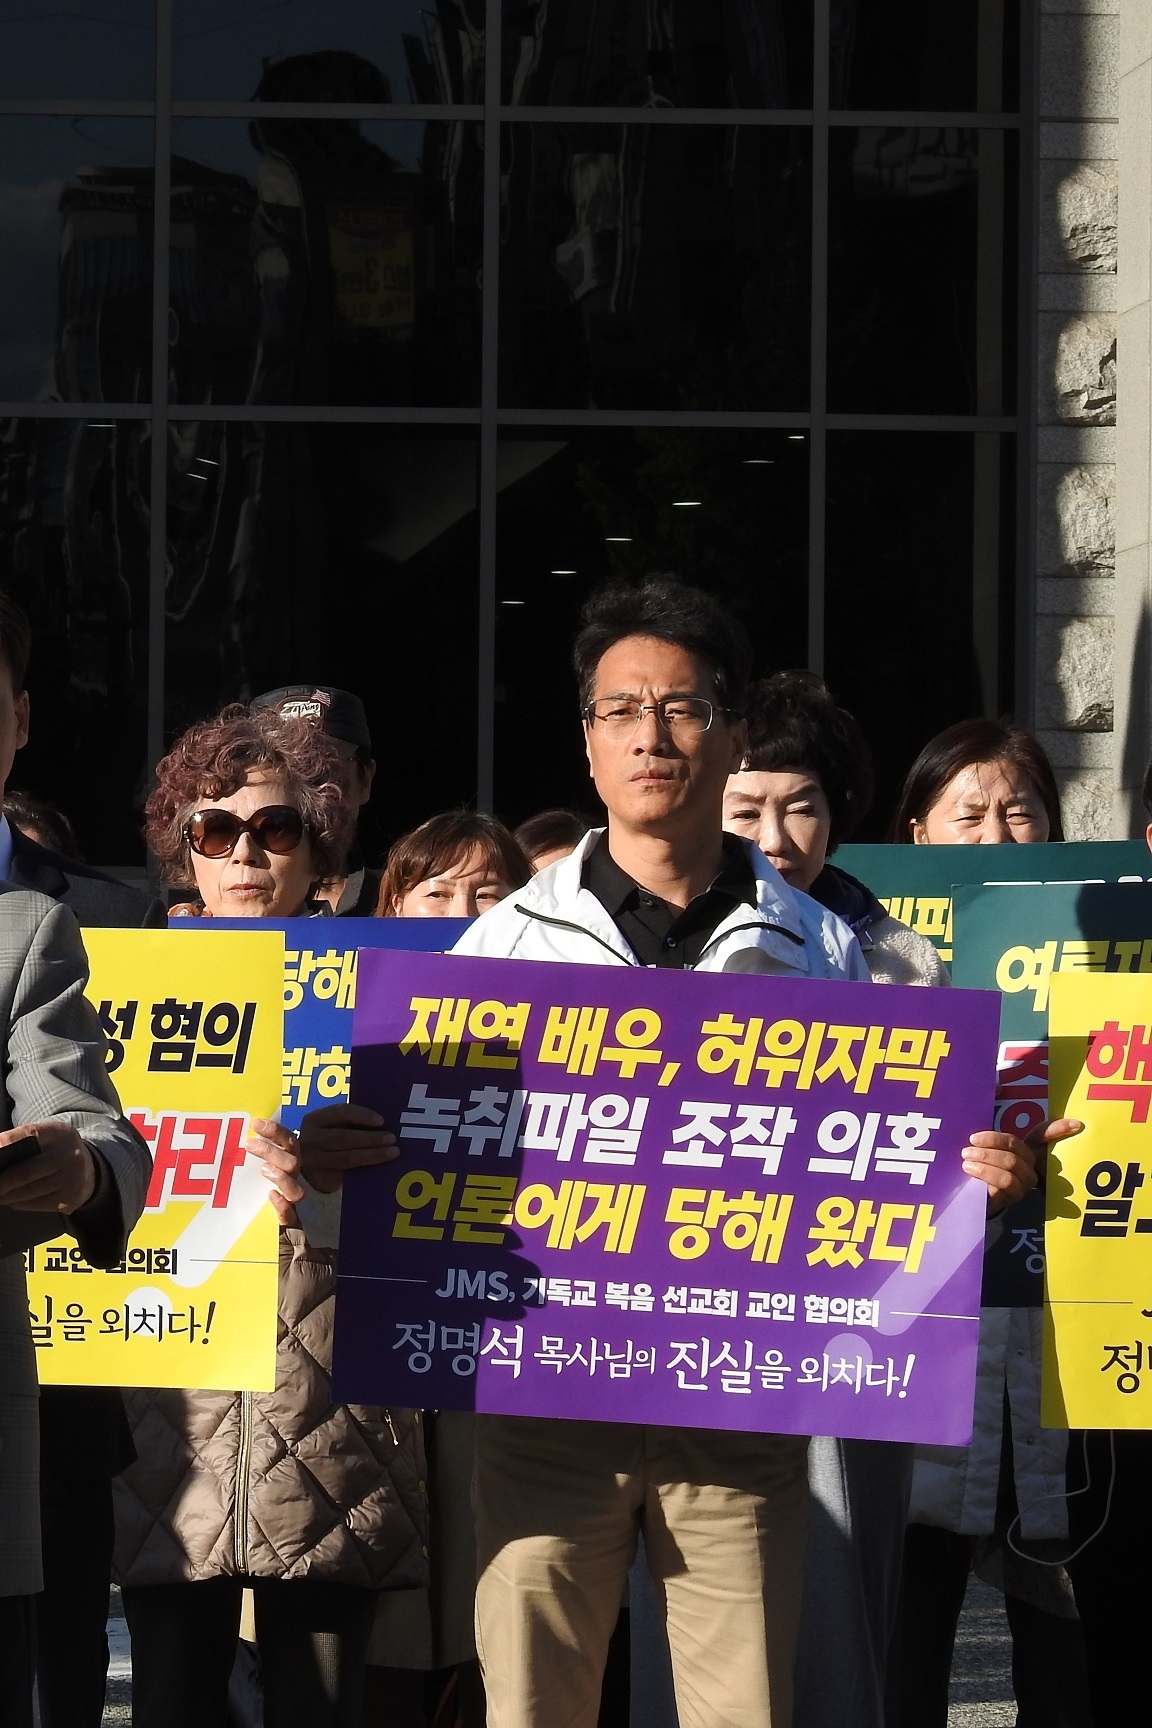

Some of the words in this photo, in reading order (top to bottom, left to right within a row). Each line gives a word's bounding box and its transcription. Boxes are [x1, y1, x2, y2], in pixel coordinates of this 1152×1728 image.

[148, 998, 258, 1073] 혐의
[399, 996, 531, 1069] 재연
[537, 1005, 681, 1087] 배우,
[696, 1013, 950, 1099] 허위자막
[662, 1102, 798, 1176] 조작
[808, 1112, 942, 1186] 의혹
[391, 1169, 647, 1254] 언론에게
[664, 1188, 792, 1265] 당해
[805, 1195, 936, 1274] 왔다
[1080, 1160, 1152, 1238] 알
[99, 1301, 216, 1345] 외치다!
[435, 1268, 517, 1304] JMS,
[522, 1276, 597, 1308] 기독교
[603, 1282, 655, 1312] 복음
[662, 1285, 739, 1317] 선교회
[745, 1291, 795, 1322] 교인
[803, 1294, 880, 1328] 협의회
[392, 1319, 525, 1379] 정명석
[533, 1335, 656, 1379] 목사님의
[667, 1336, 792, 1394] 진실을
[797, 1353, 916, 1399] 외치다!
[1101, 1340, 1152, 1394] 정
